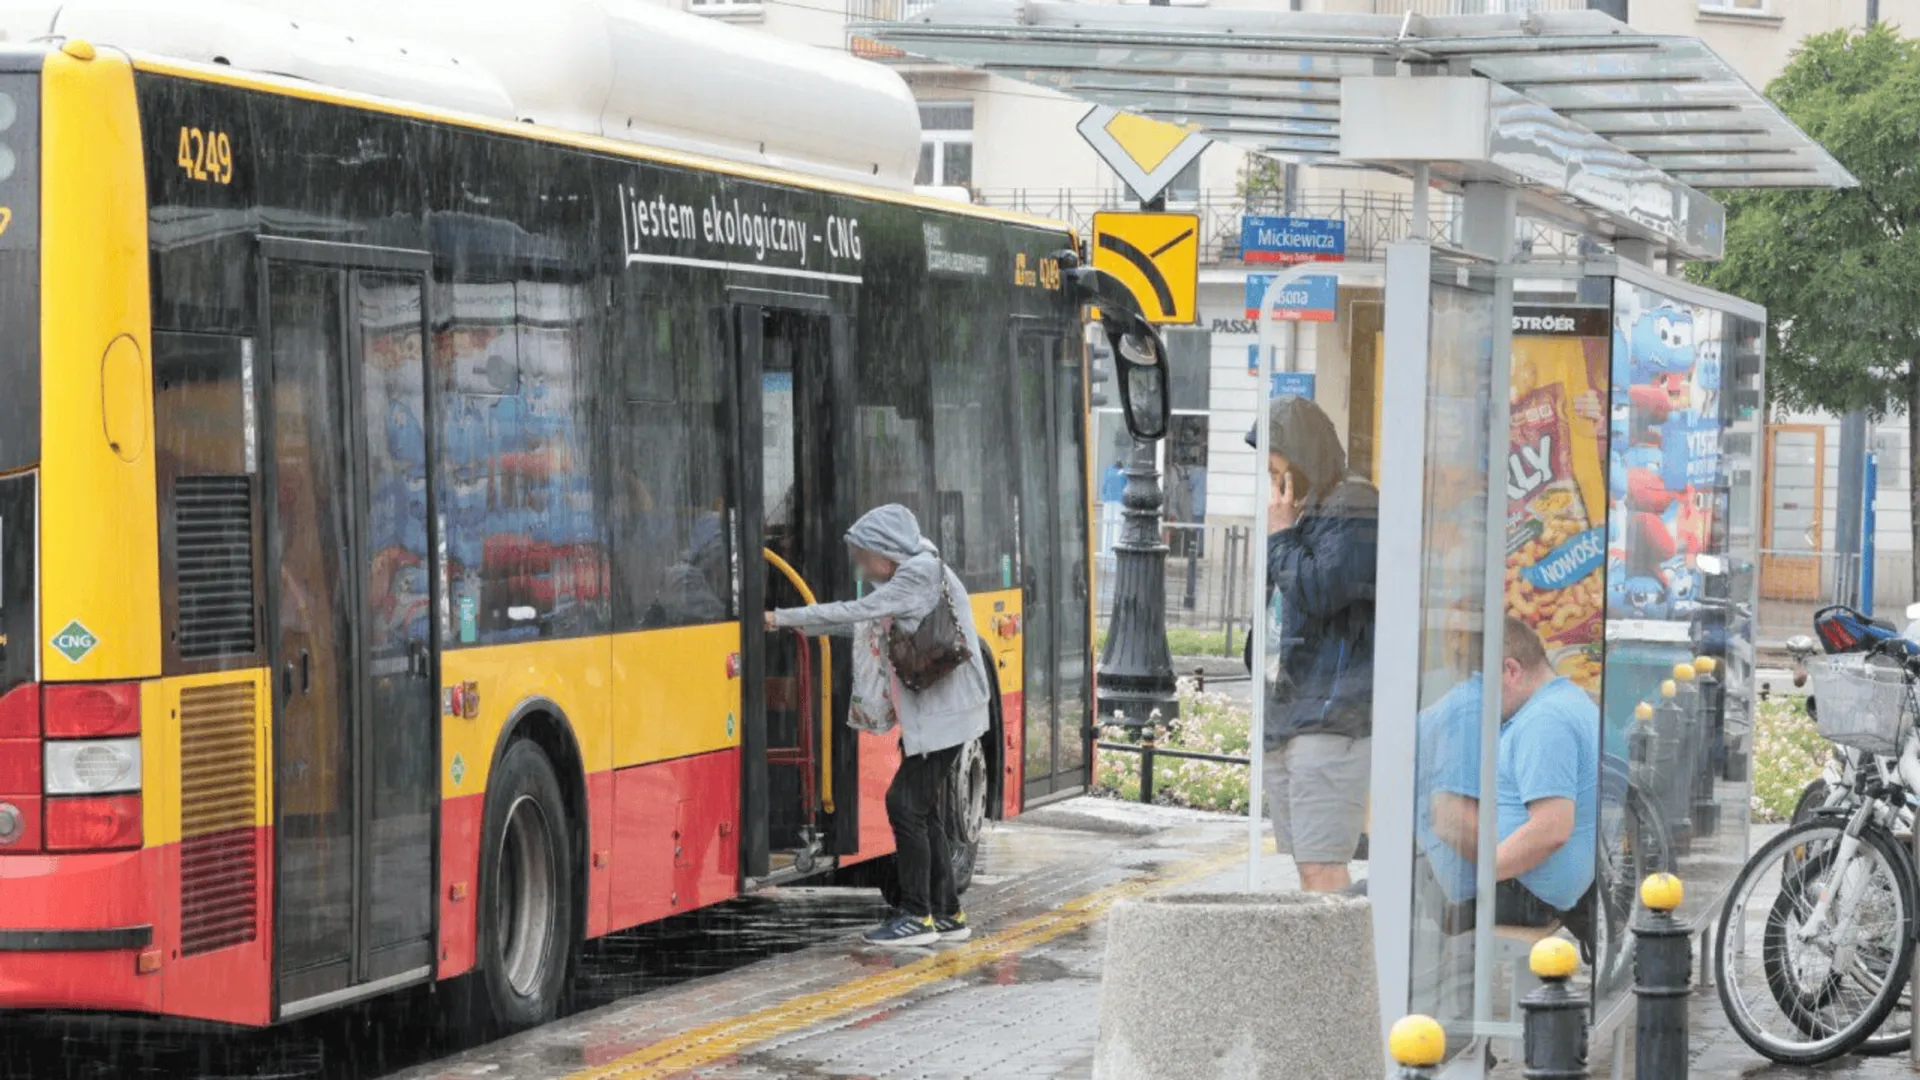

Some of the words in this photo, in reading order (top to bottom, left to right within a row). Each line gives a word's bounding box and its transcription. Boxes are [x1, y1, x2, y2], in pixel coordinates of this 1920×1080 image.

[178, 125, 232, 185] 4249
[629, 186, 697, 251] jestem
[702, 194, 807, 266] ekologiczny
[826, 213, 862, 260] CNG
[1257, 227, 1335, 248] Mickiewicza
[1539, 531, 1605, 585] NOWOŚĆ
[58, 634, 93, 649] CNG
